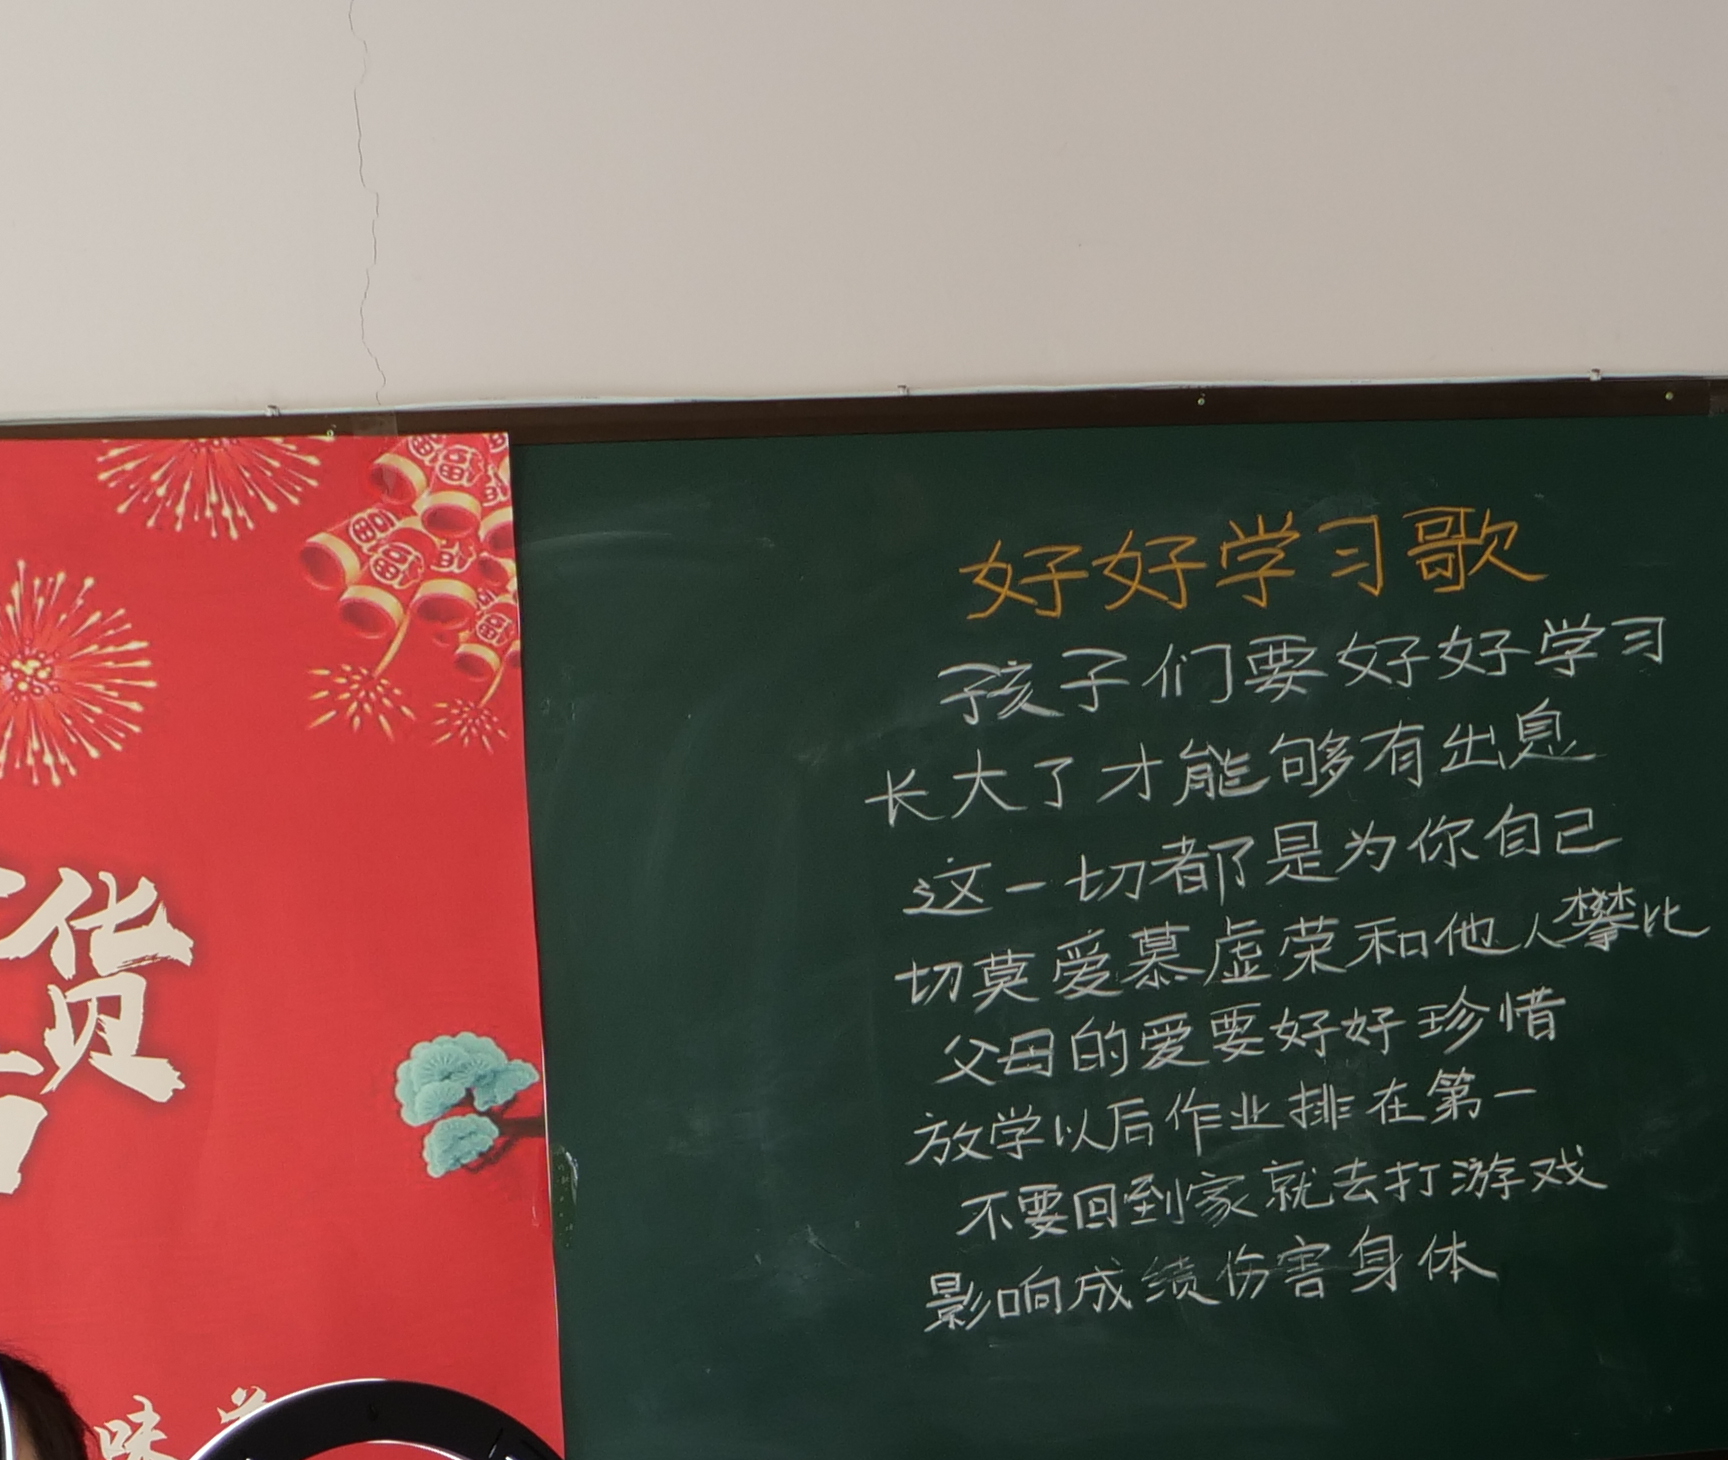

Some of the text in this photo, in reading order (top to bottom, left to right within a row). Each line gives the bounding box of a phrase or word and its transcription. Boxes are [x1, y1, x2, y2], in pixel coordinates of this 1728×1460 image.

[958, 507, 1547, 619] 好好学习歌
[938, 612, 1665, 725] 孩子们要好好学习
[865, 698, 1606, 828] 长大了才能够有出息
[902, 802, 1621, 917] 这一切都是为你自己
[896, 881, 1711, 1012] 切莫爱慕虚荣和他人攀比
[935, 985, 1566, 1086] 父母的爱要好好珍惜
[906, 1065, 1537, 1167] 放学以后作业排在第一
[955, 1146, 1609, 1240] 不要回到家就去打游戏
[923, 1229, 1500, 1332] 影响成绩伤害身体
